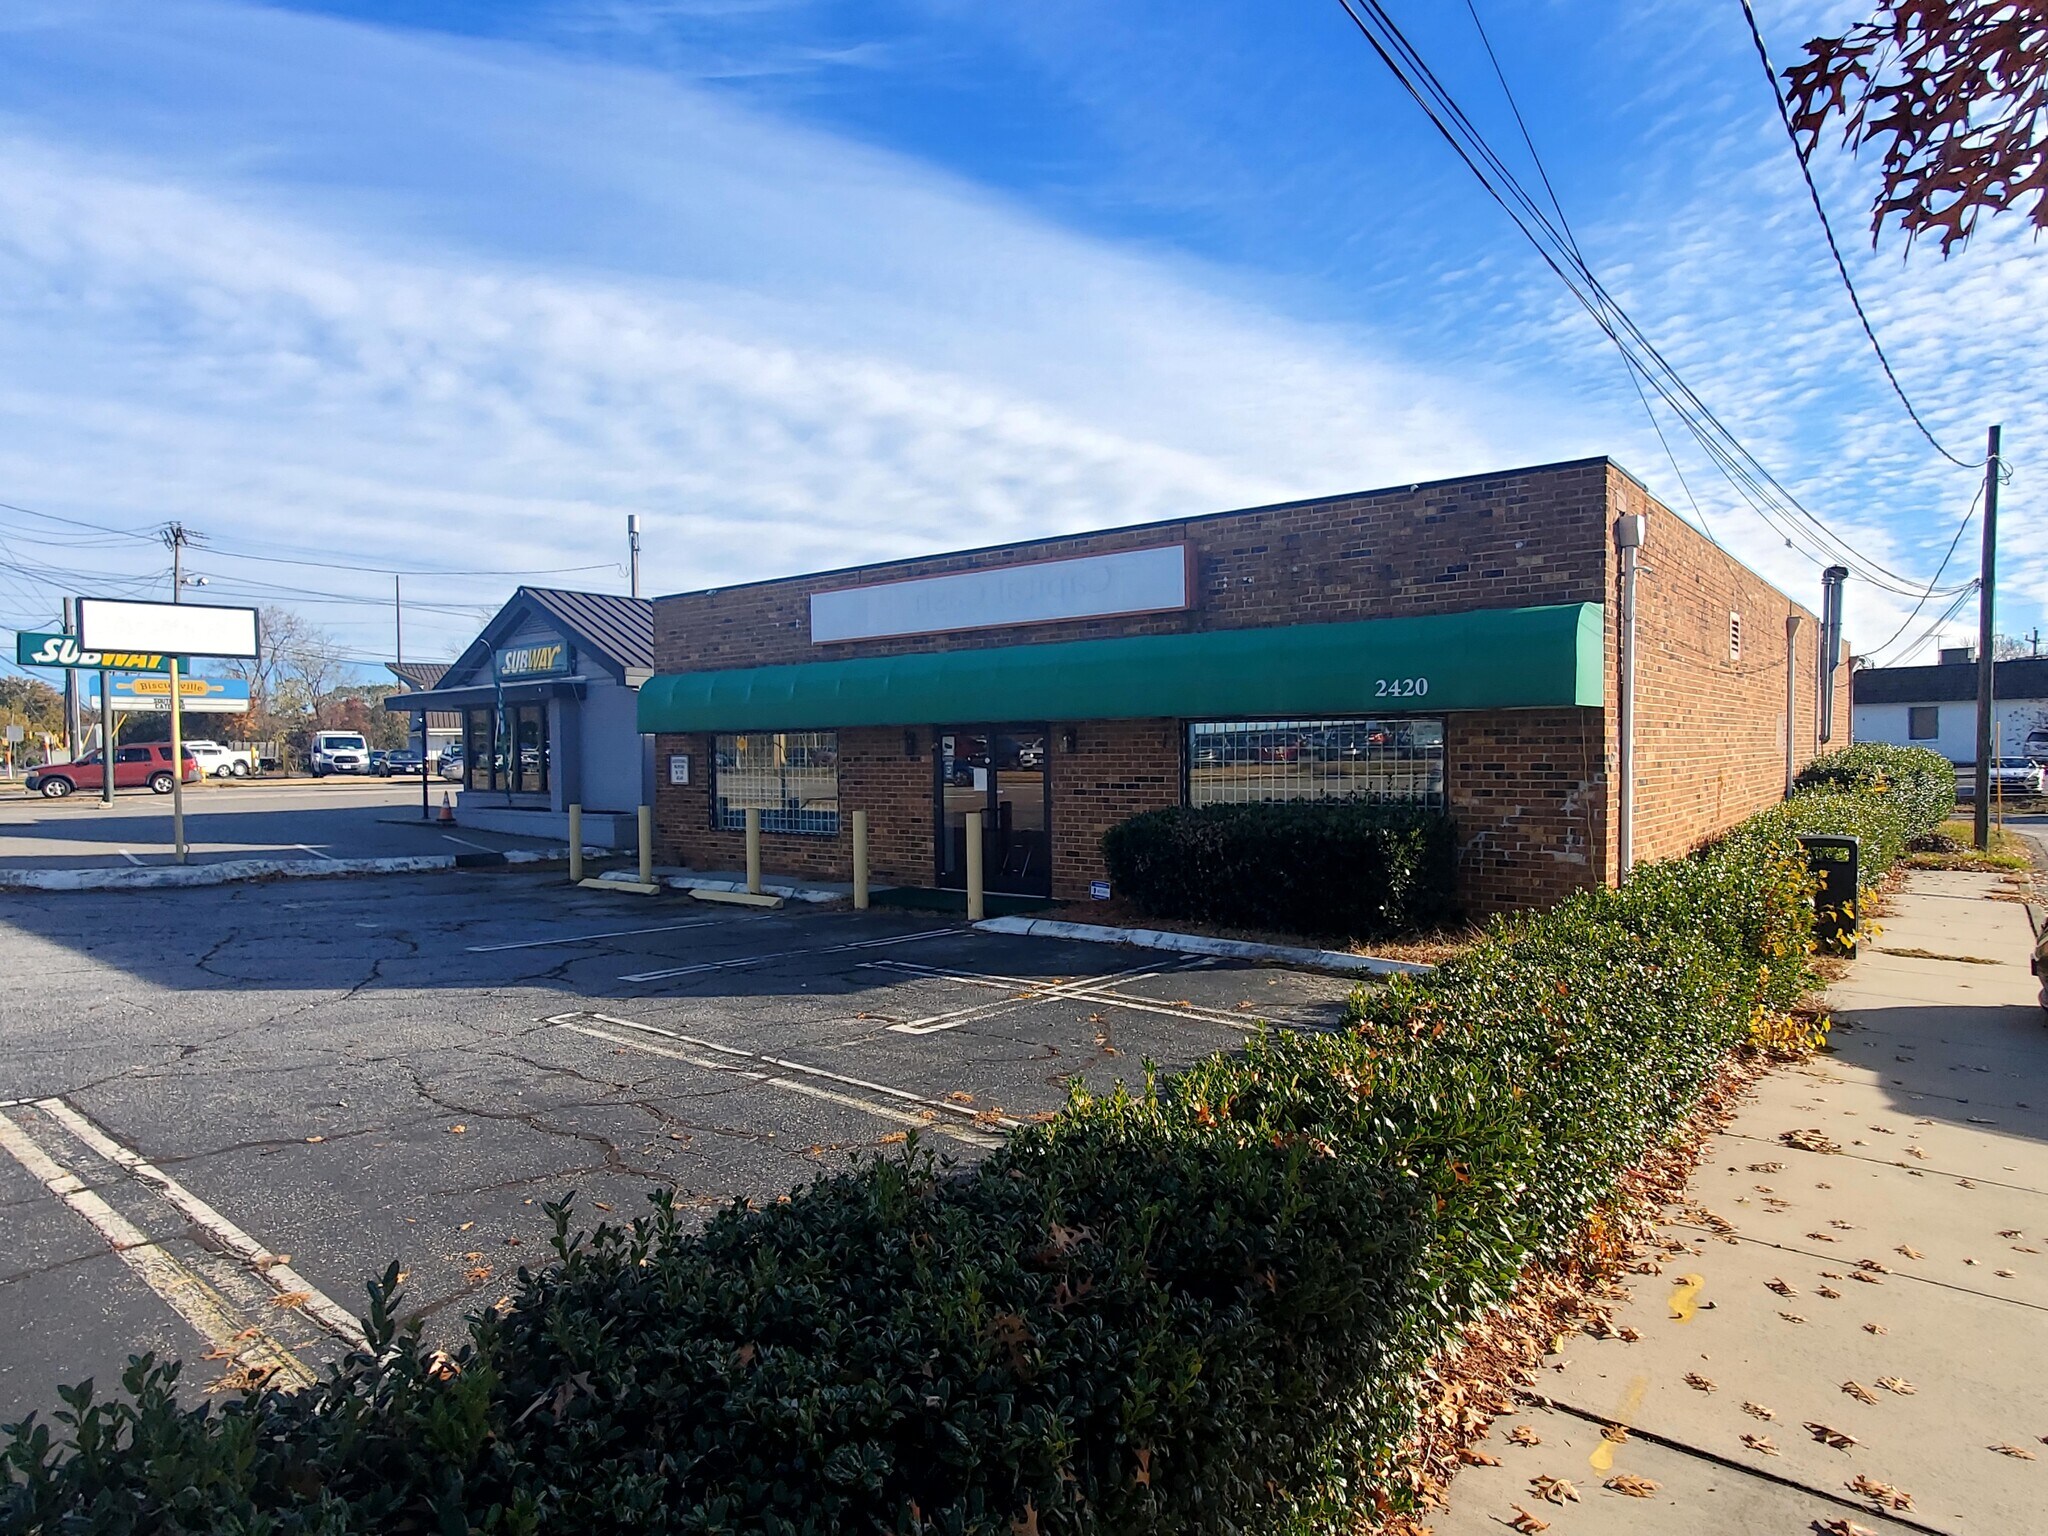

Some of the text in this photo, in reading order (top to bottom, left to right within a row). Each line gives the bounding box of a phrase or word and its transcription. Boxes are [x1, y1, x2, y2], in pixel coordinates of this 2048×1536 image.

[501, 643, 561, 675] SUBWAY
[139, 681, 203, 692] Biscuville
[1374, 677, 1429, 697] 2420
